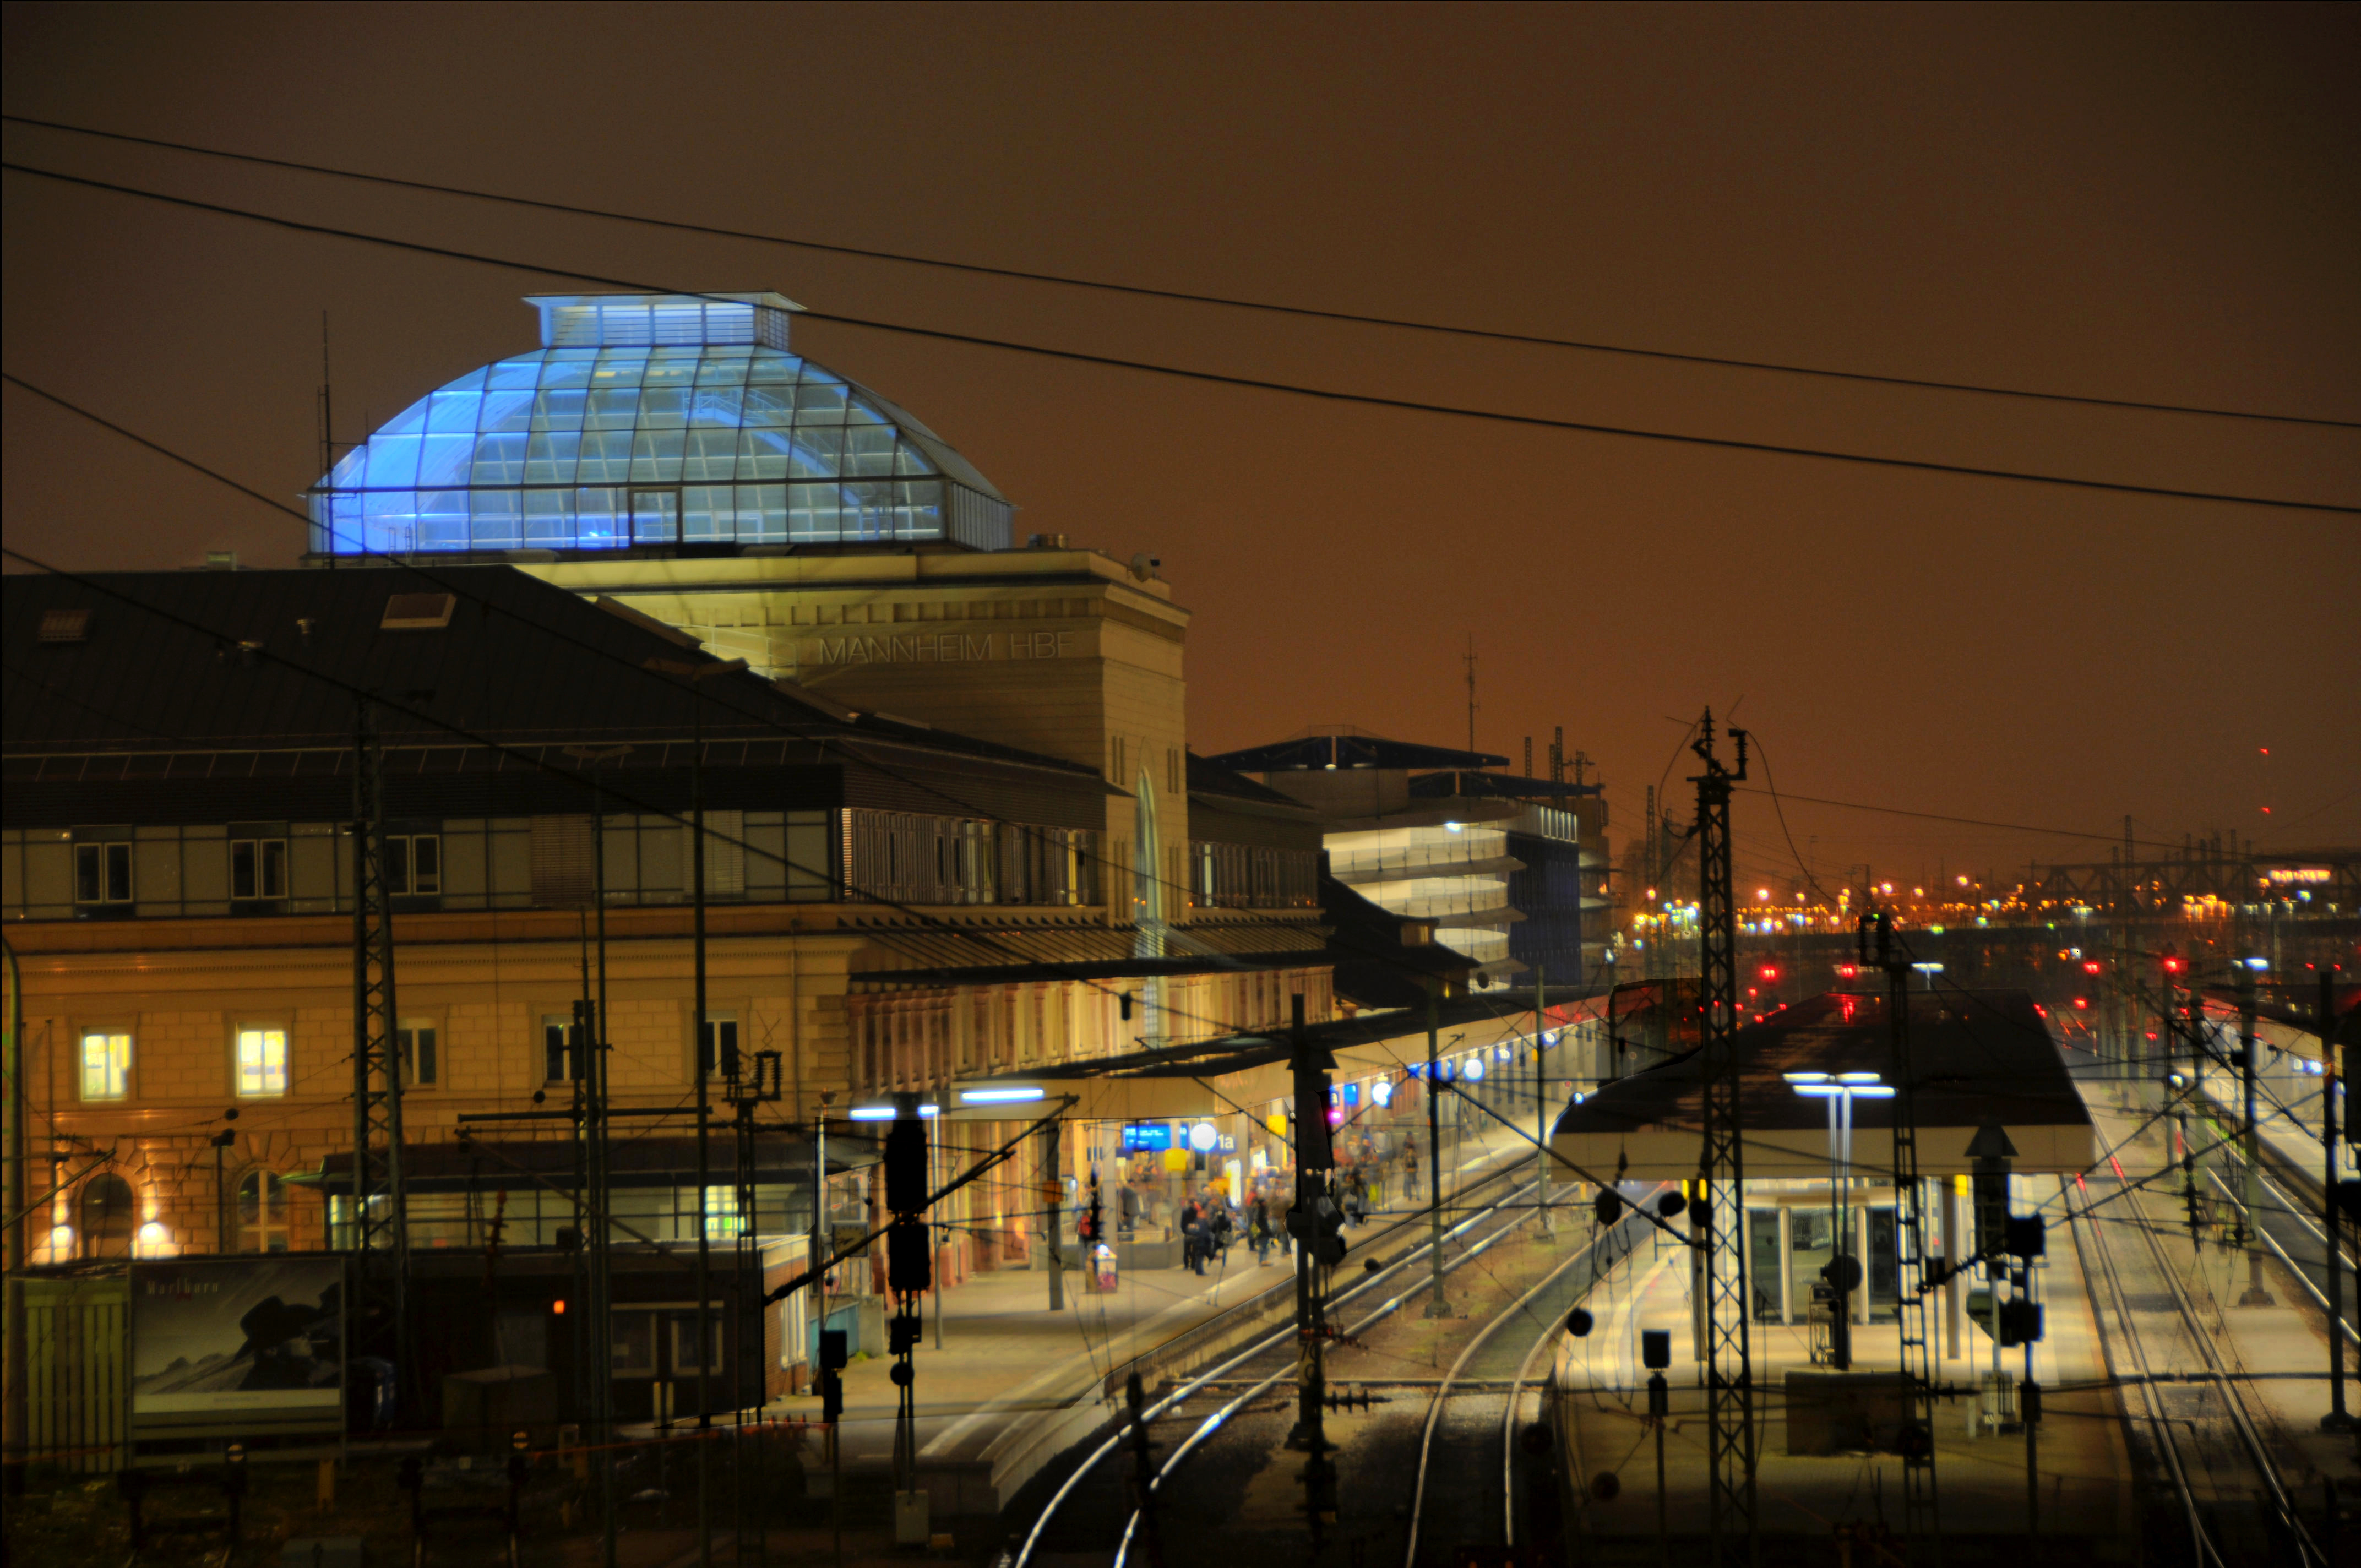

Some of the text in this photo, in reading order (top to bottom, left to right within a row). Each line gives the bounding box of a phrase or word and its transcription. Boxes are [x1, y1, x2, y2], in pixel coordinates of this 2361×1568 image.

[819, 631, 1075, 665] MANNHEIM HBF
[1218, 1134, 1234, 1149] 1a
[146, 1277, 218, 1295] Marlboro
